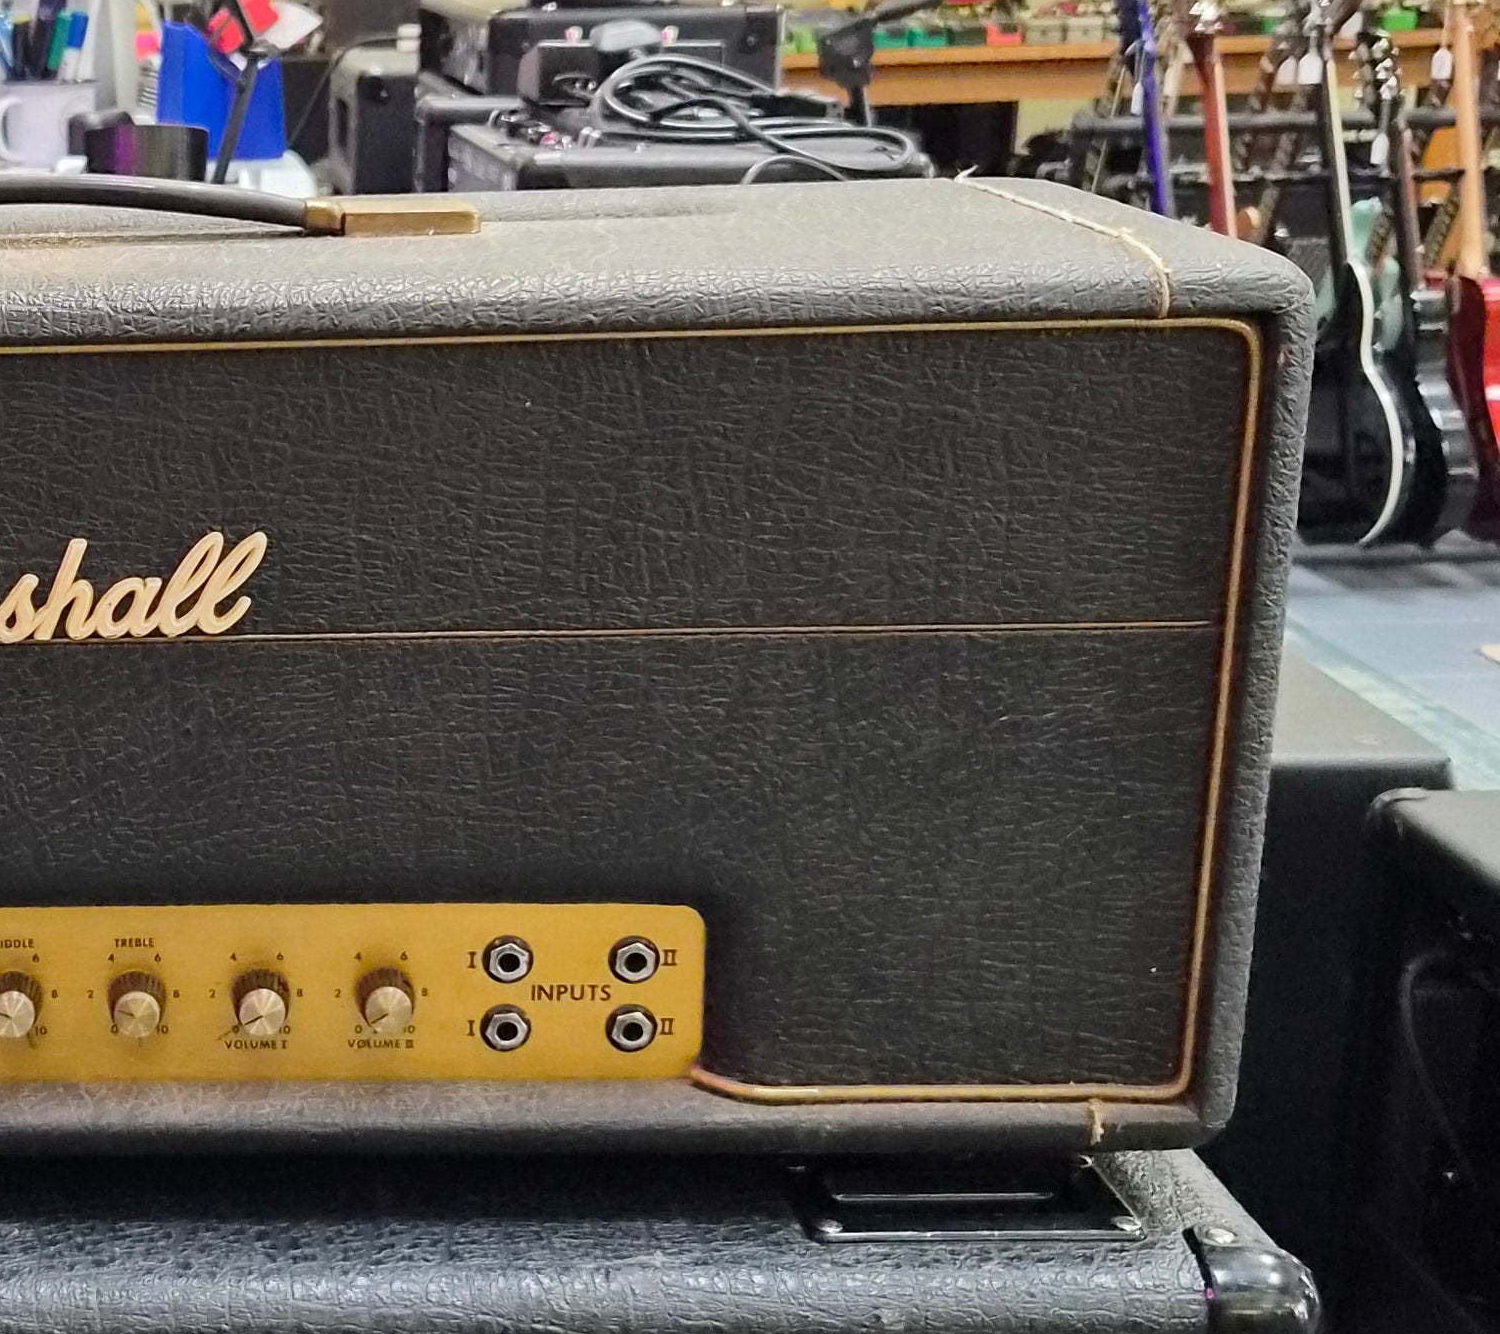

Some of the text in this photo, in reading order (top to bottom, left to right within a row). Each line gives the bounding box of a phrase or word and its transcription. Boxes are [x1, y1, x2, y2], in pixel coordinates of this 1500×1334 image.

[114, 938, 154, 948] TREBLE
[32, 953, 40, 963] 6
[107, 953, 115, 963] 4
[154, 953, 162, 963] 6
[229, 952, 237, 961] 4
[276, 952, 284, 961] 6
[353, 952, 362, 961] 4
[400, 951, 408, 961] 6
[466, 951, 477, 968] I
[661, 949, 677, 966] II
[51, 989, 58, 998] 8
[87, 989, 94, 999] 2
[172, 989, 180, 998] 8
[209, 989, 216, 998] 2
[296, 988, 303, 997] 8
[334, 988, 342, 998] 2
[531, 984, 611, 1001] INPUTS
[36, 1025, 47, 1035] 10
[156, 1024, 169, 1034] 10
[354, 1025, 362, 1034] 0
[465, 1019, 476, 1036] I
[659, 1017, 674, 1035] II
[225, 1040, 277, 1049] VOLUME
[348, 1039, 400, 1048] VOLUME
